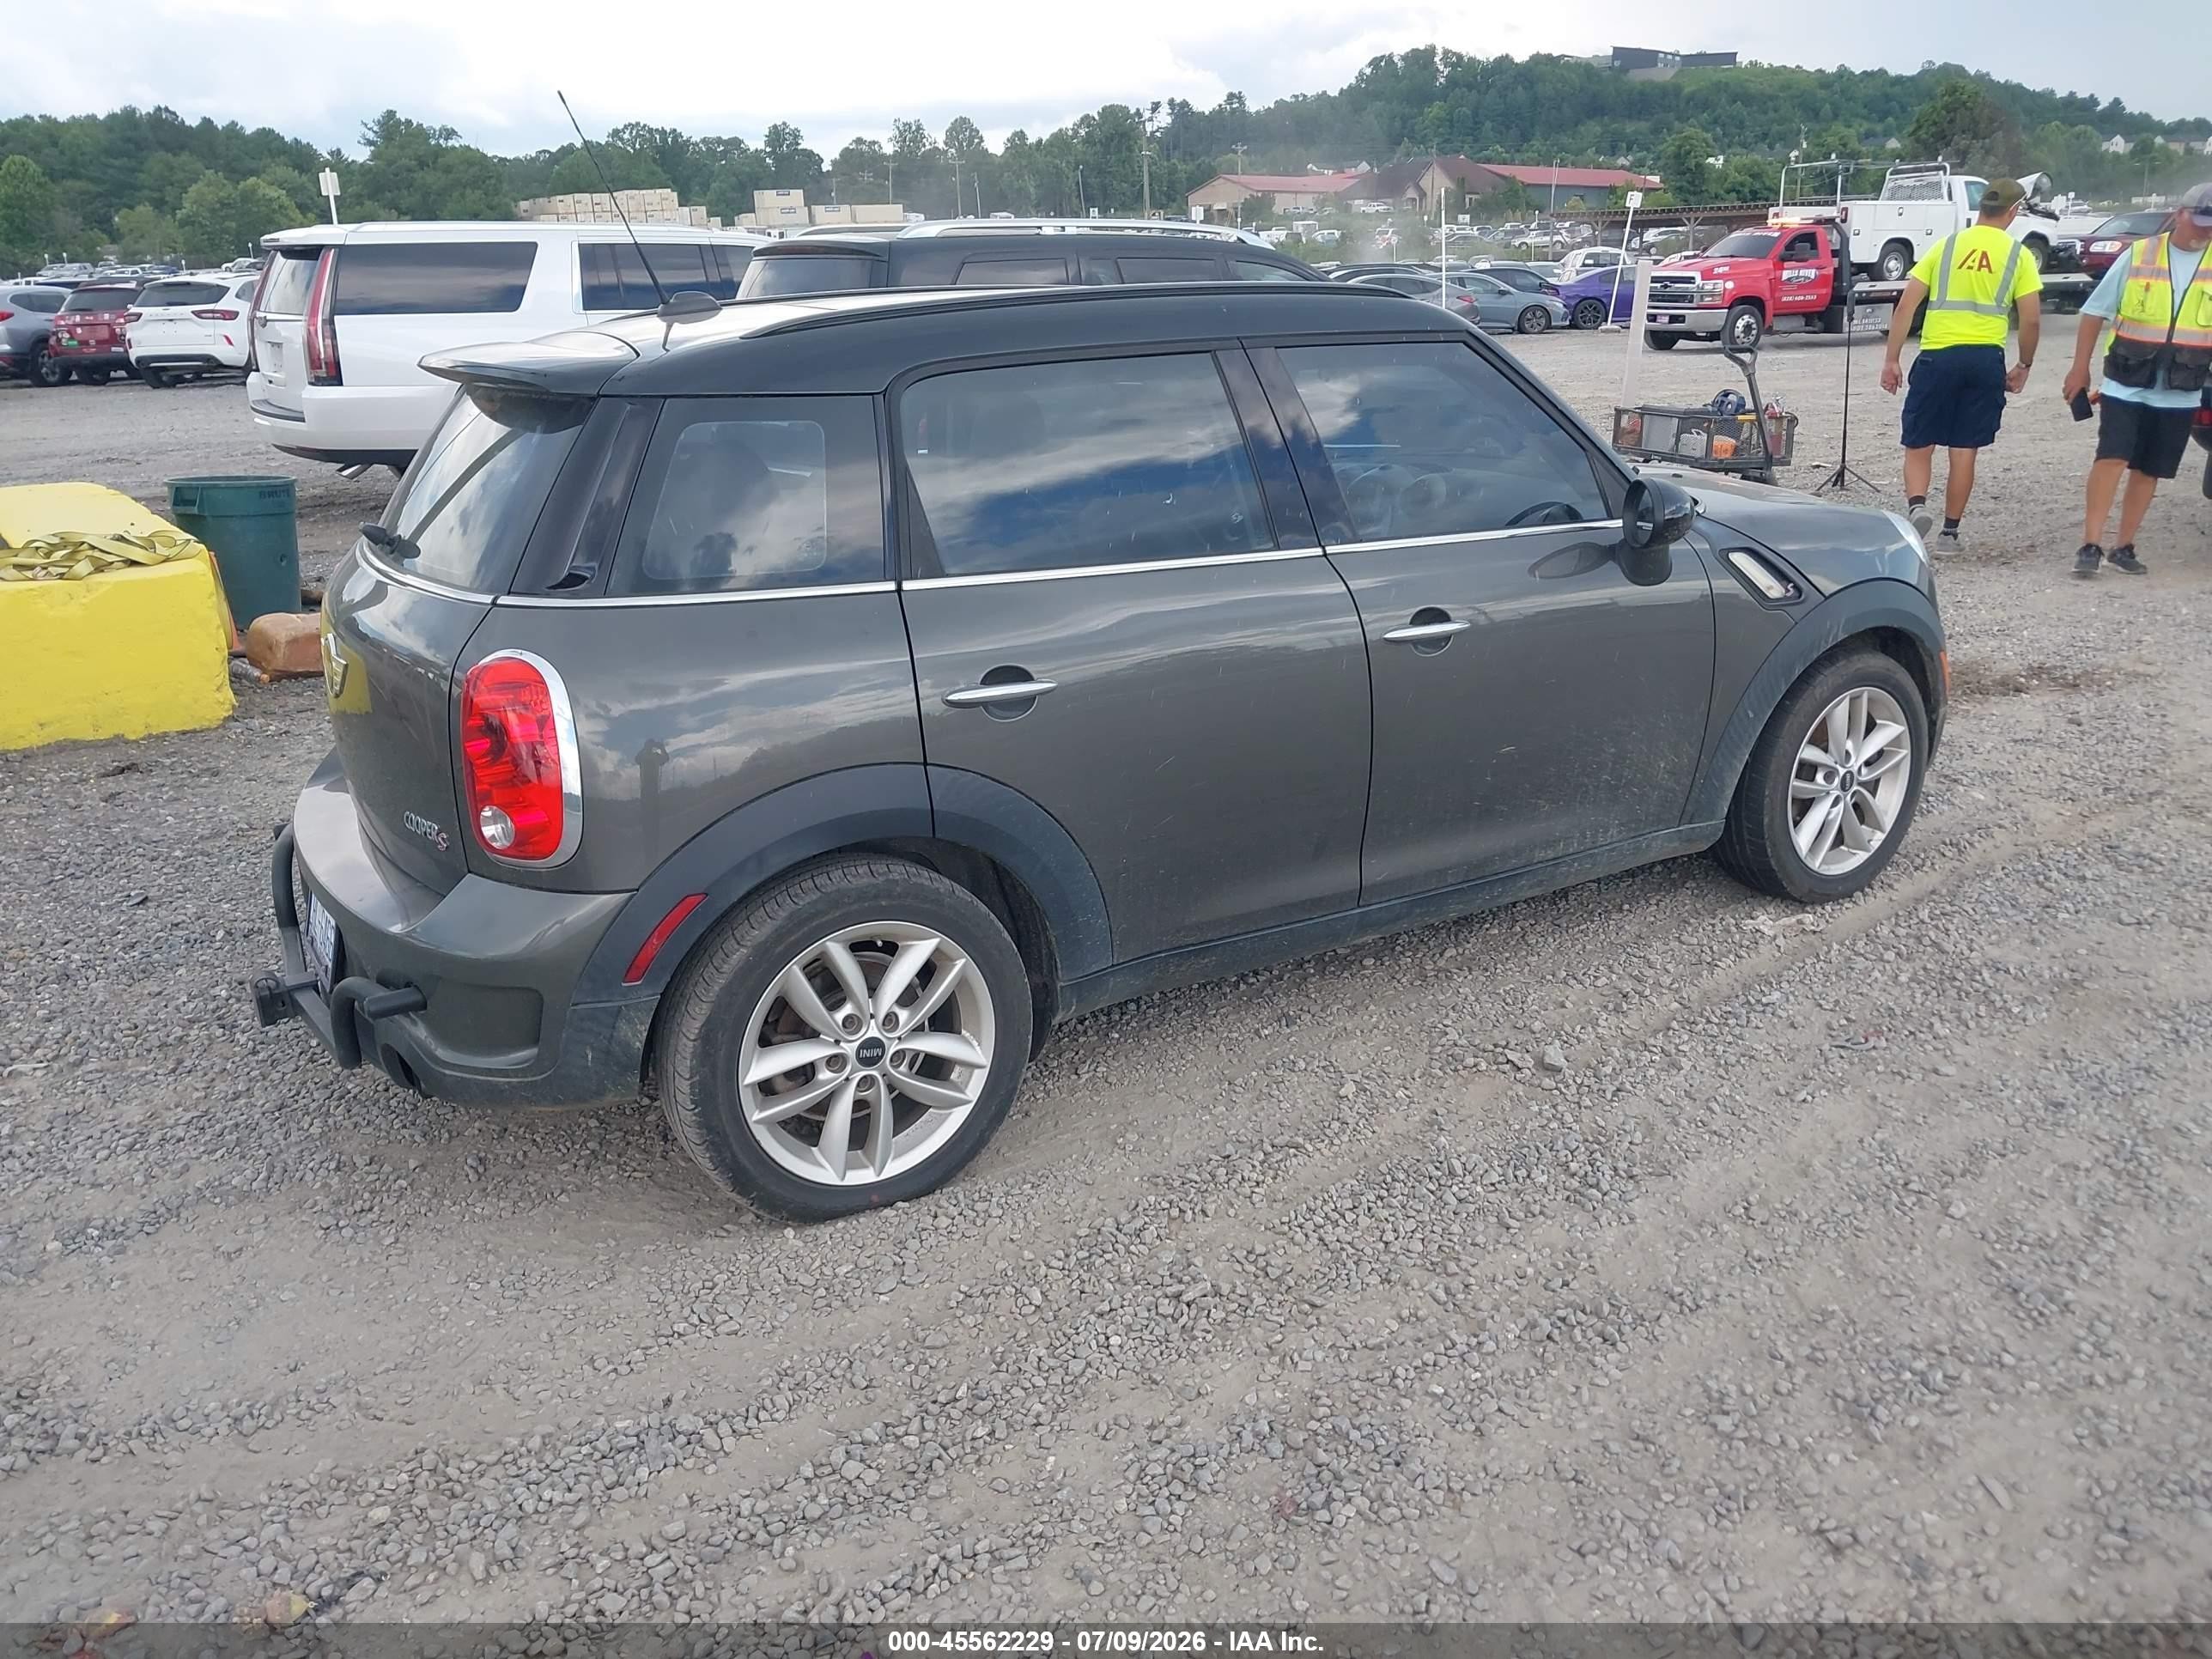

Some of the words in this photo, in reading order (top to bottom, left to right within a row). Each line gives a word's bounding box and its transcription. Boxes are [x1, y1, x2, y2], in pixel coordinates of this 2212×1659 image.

[404, 811, 440, 843] COOPER
[437, 832, 449, 851] S
[860, 1048, 882, 1059] MINI
